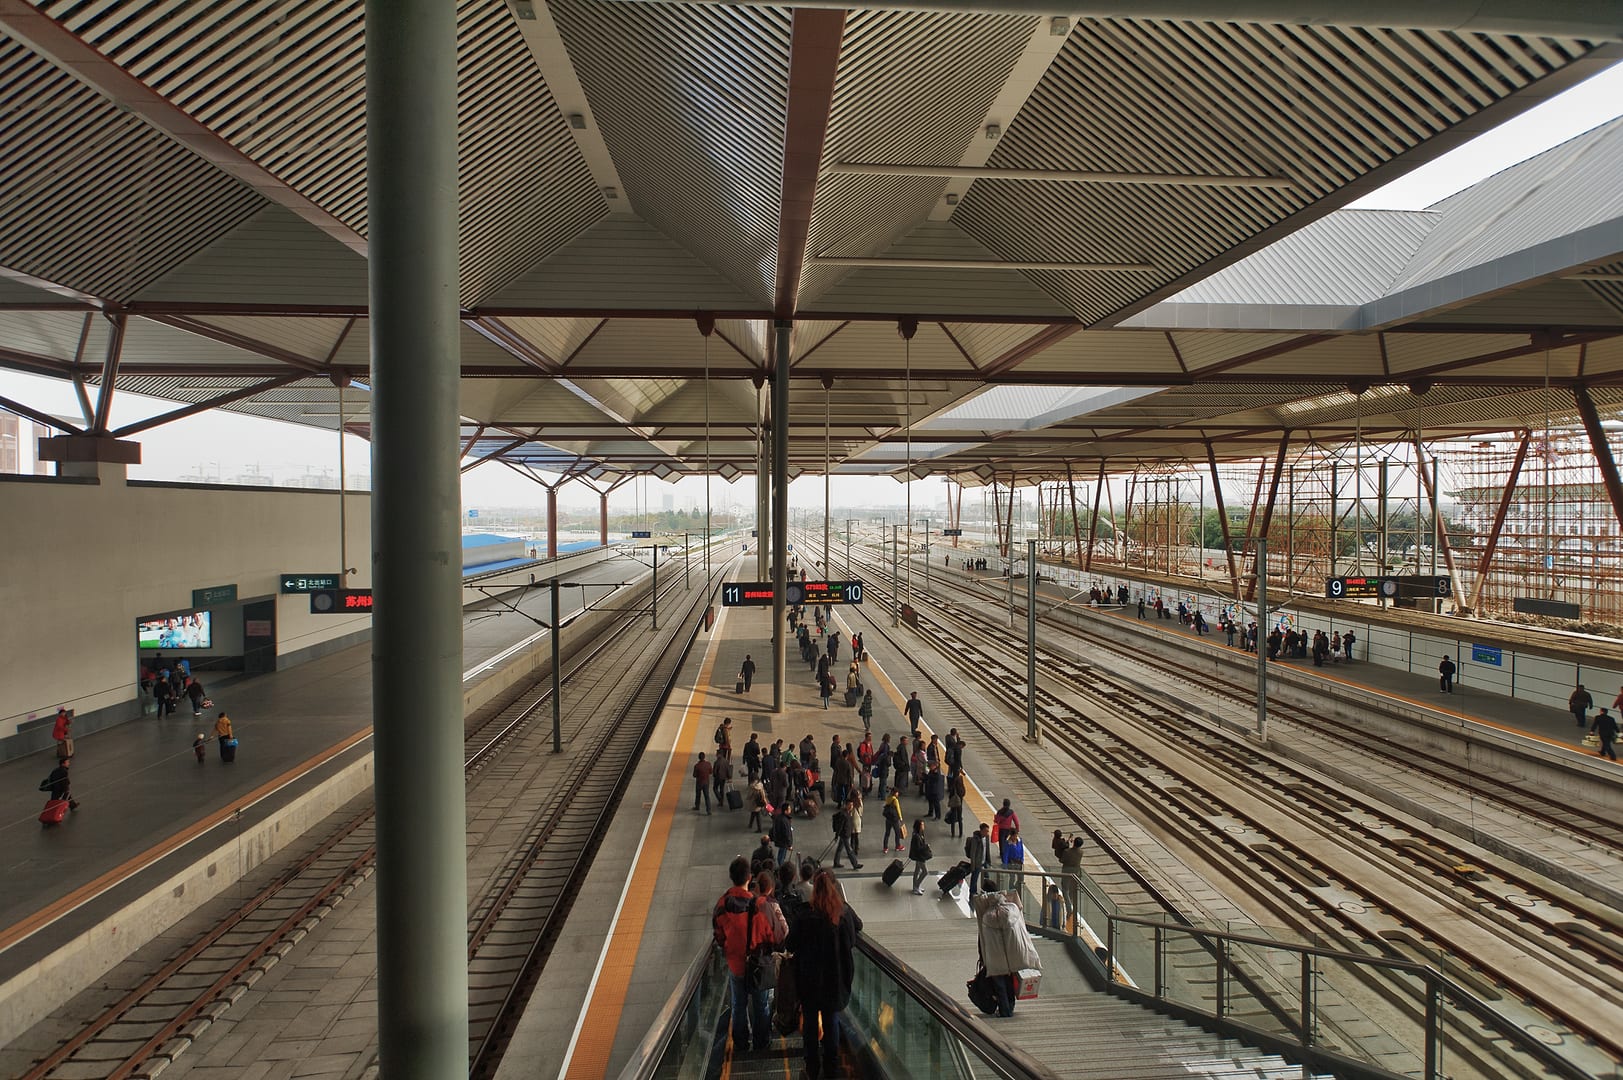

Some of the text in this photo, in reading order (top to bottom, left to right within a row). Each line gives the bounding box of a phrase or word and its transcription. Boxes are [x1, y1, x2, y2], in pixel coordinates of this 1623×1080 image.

[845, 585, 861, 600] 10
[1331, 580, 1342, 596] 9
[1438, 579, 1448, 594] 8
[725, 587, 739, 602] 11
